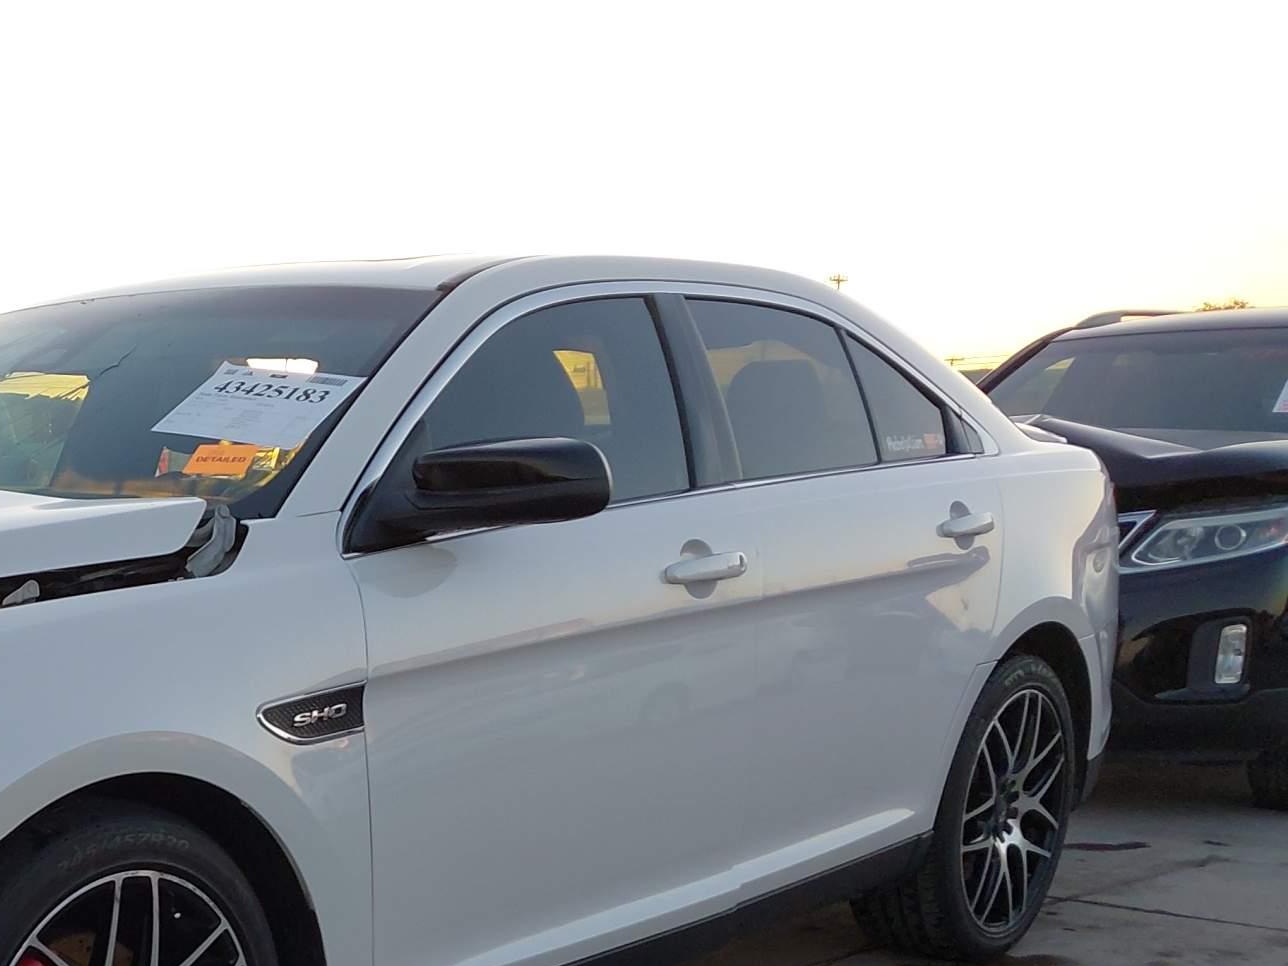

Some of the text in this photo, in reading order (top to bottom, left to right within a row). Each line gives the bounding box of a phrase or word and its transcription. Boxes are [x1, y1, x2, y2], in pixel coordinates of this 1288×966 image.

[213, 379, 331, 404] 43425183
[195, 456, 247, 464] DETAILED
[293, 703, 347, 727] SHO
